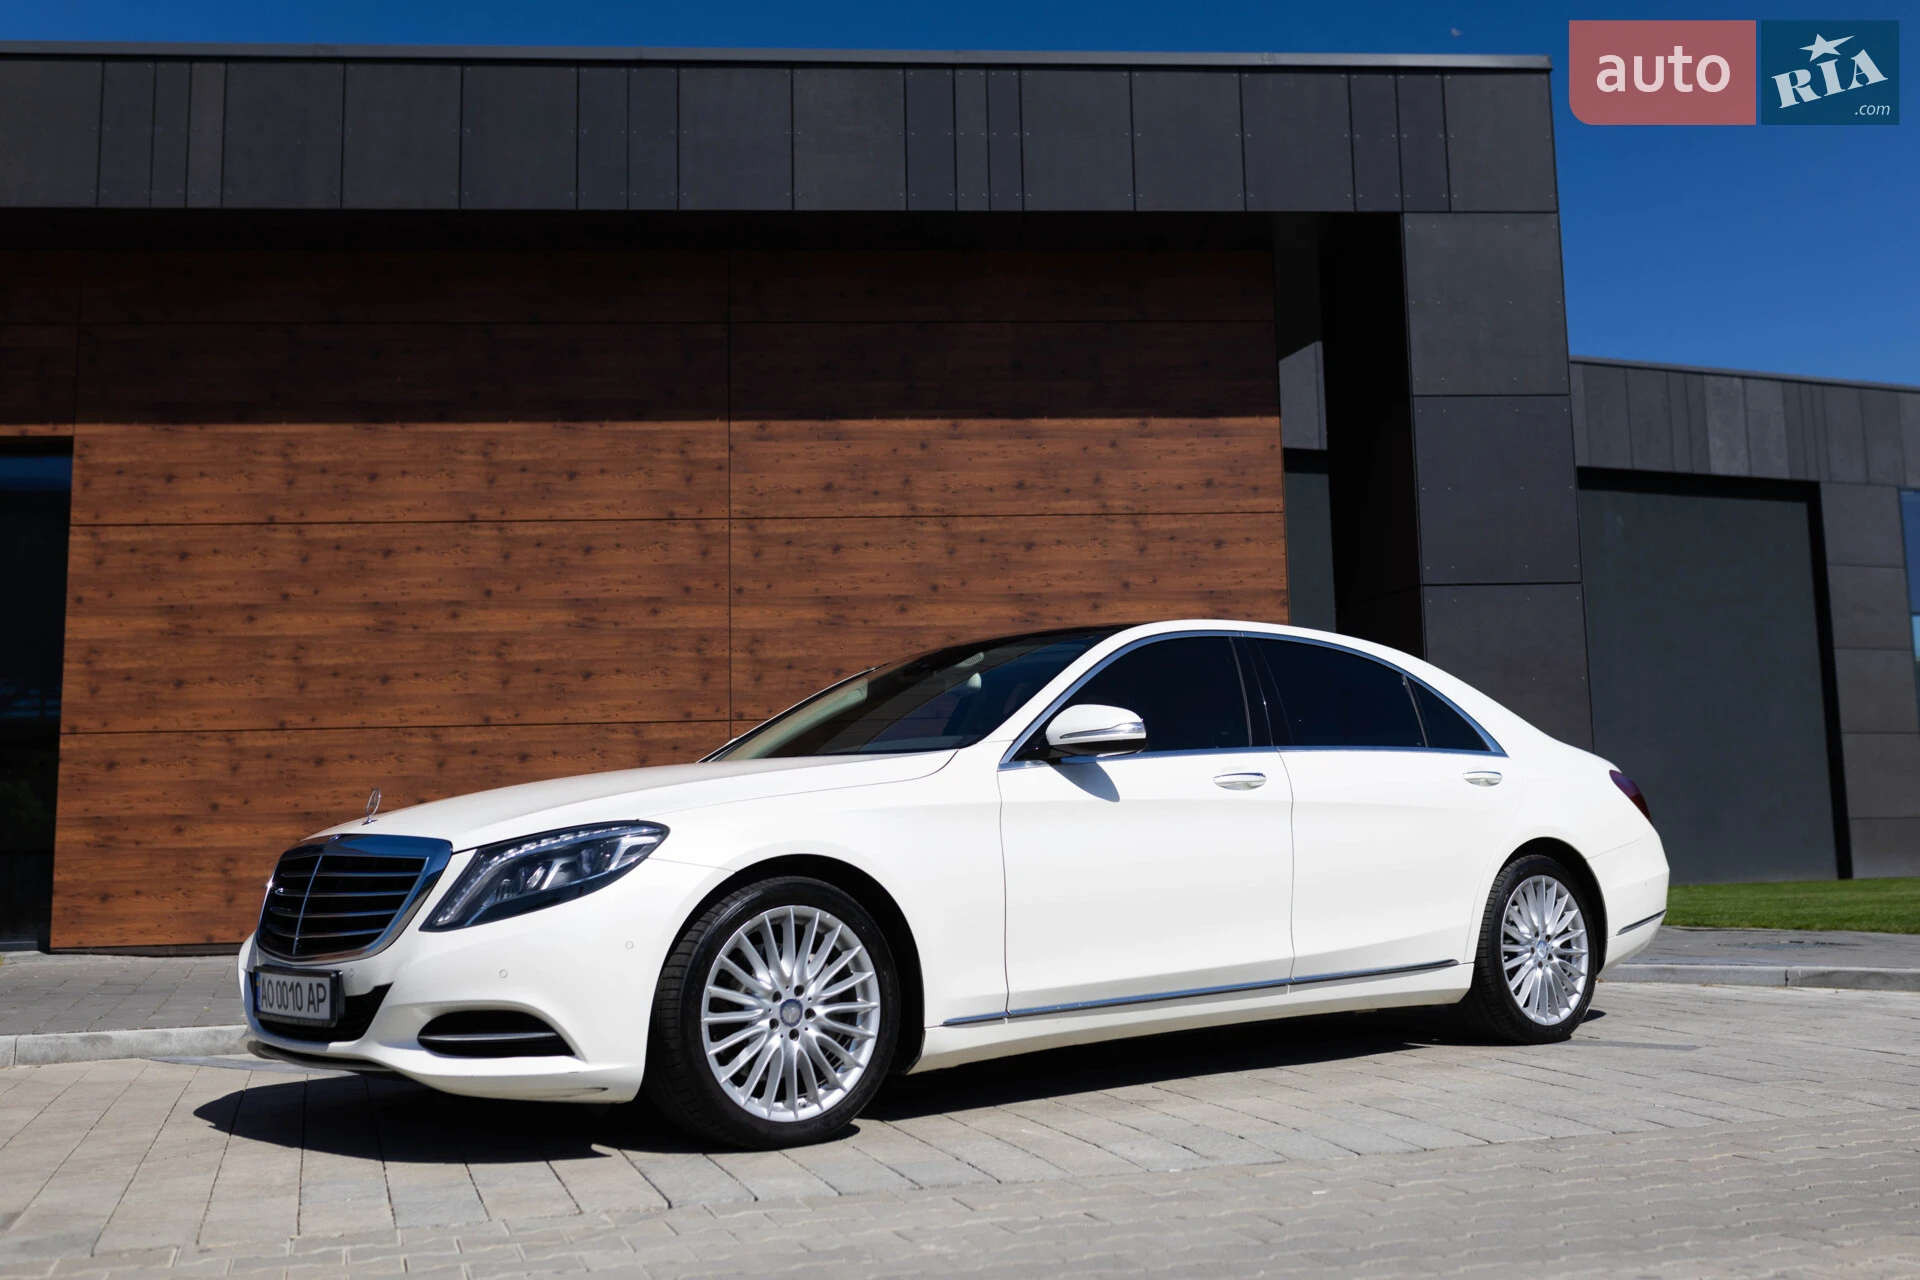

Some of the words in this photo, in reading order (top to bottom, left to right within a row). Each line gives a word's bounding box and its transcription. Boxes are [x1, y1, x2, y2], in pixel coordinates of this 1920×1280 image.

[261, 978, 274, 1008] AO
[276, 980, 303, 1012] 0010
[307, 983, 327, 1013] AP
